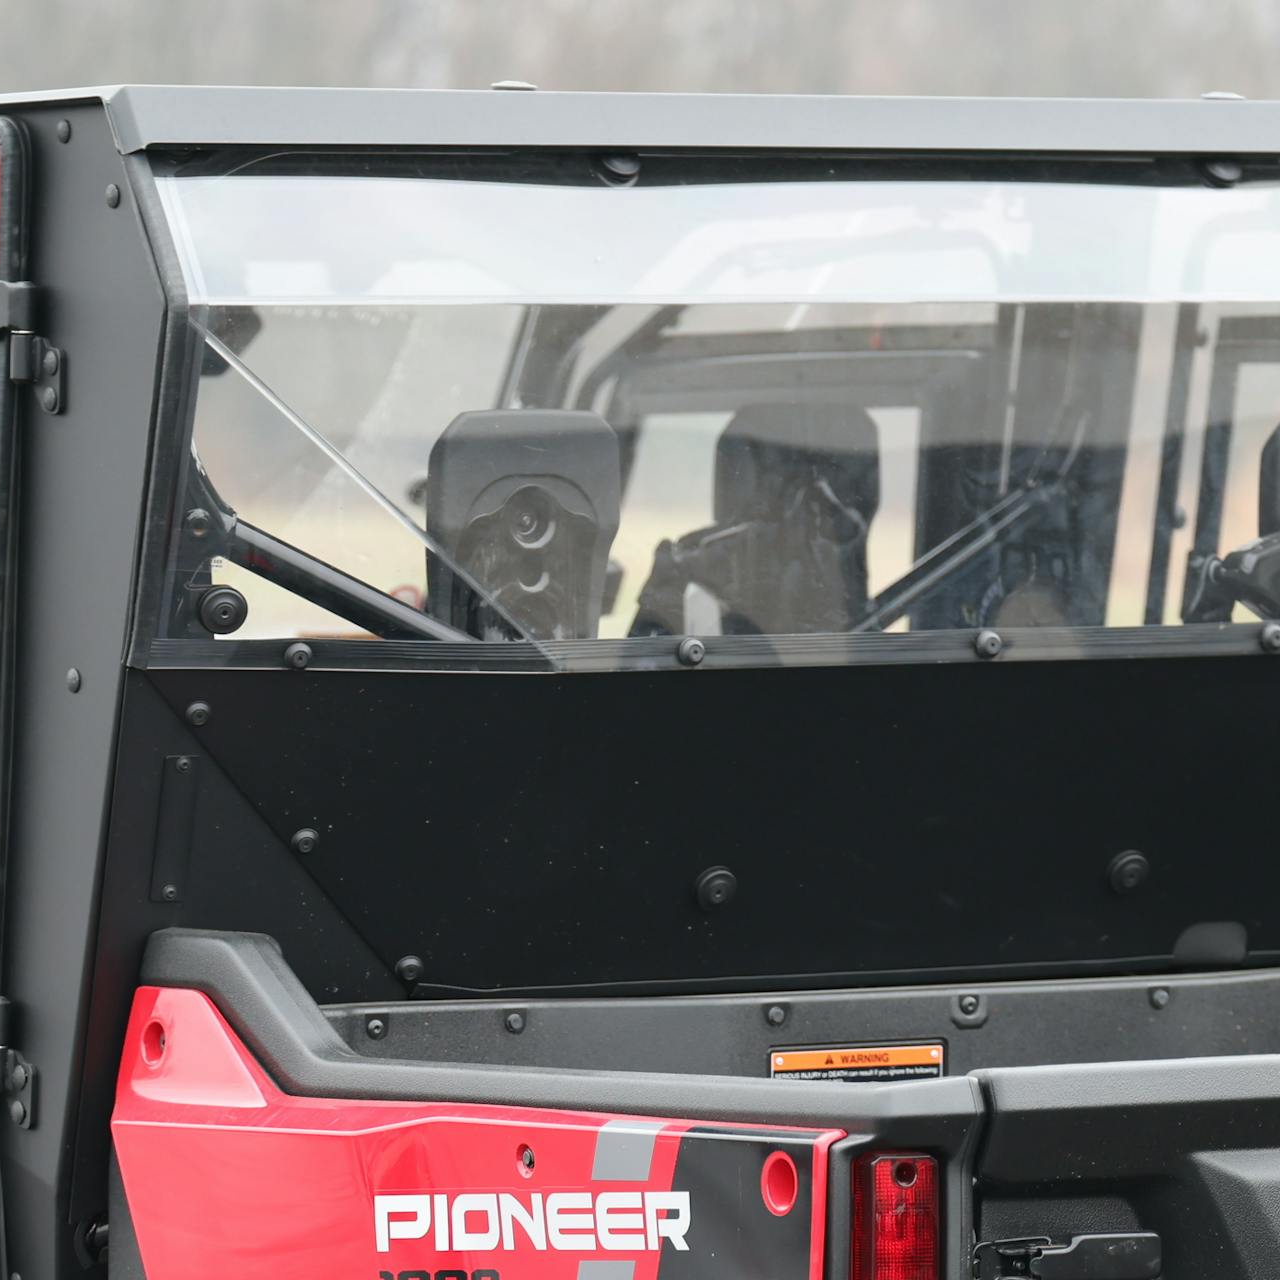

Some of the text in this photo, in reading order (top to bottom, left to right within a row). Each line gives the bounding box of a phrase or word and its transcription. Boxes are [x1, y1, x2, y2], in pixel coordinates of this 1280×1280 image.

[840, 1052, 890, 1064] WARNING
[801, 1071, 821, 1079] INJURY
[828, 1070, 847, 1078] DEATH
[373, 1191, 691, 1252] PIONEER
